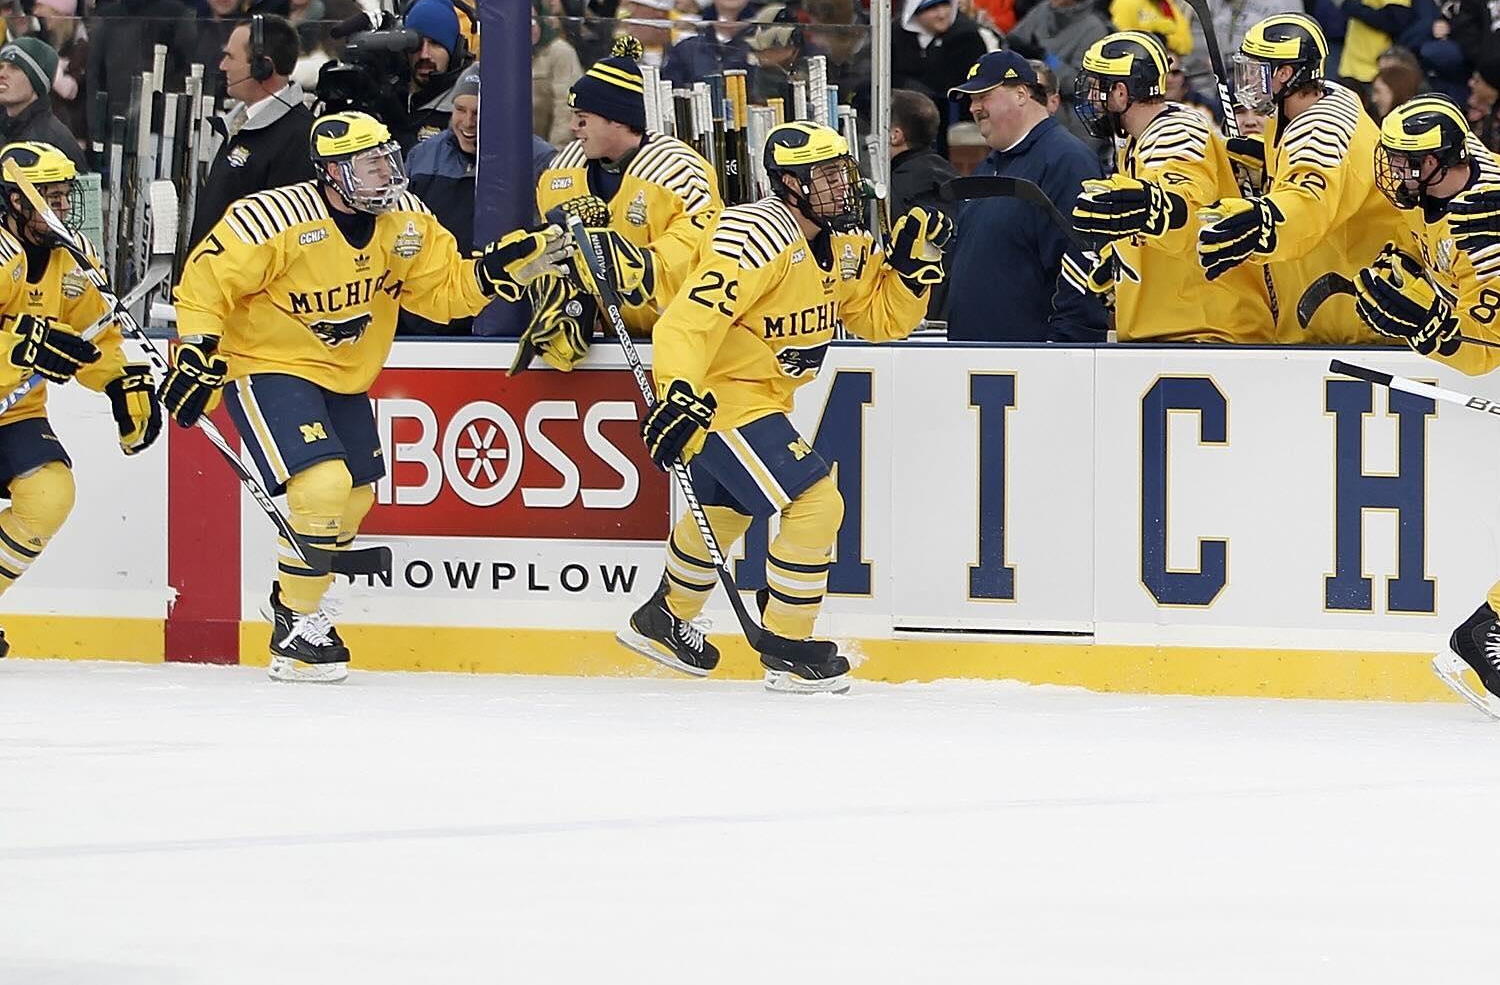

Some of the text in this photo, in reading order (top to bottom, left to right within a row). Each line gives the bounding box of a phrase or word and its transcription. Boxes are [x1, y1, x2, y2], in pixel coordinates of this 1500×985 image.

[1149, 85, 1160, 96] 19
[193, 233, 225, 264] 7
[85, 268, 168, 374] EASTO
[300, 421, 328, 444] M
[376, 398, 640, 509] BOSS
[787, 437, 812, 461] M
[348, 560, 638, 593] NOWPLOW
